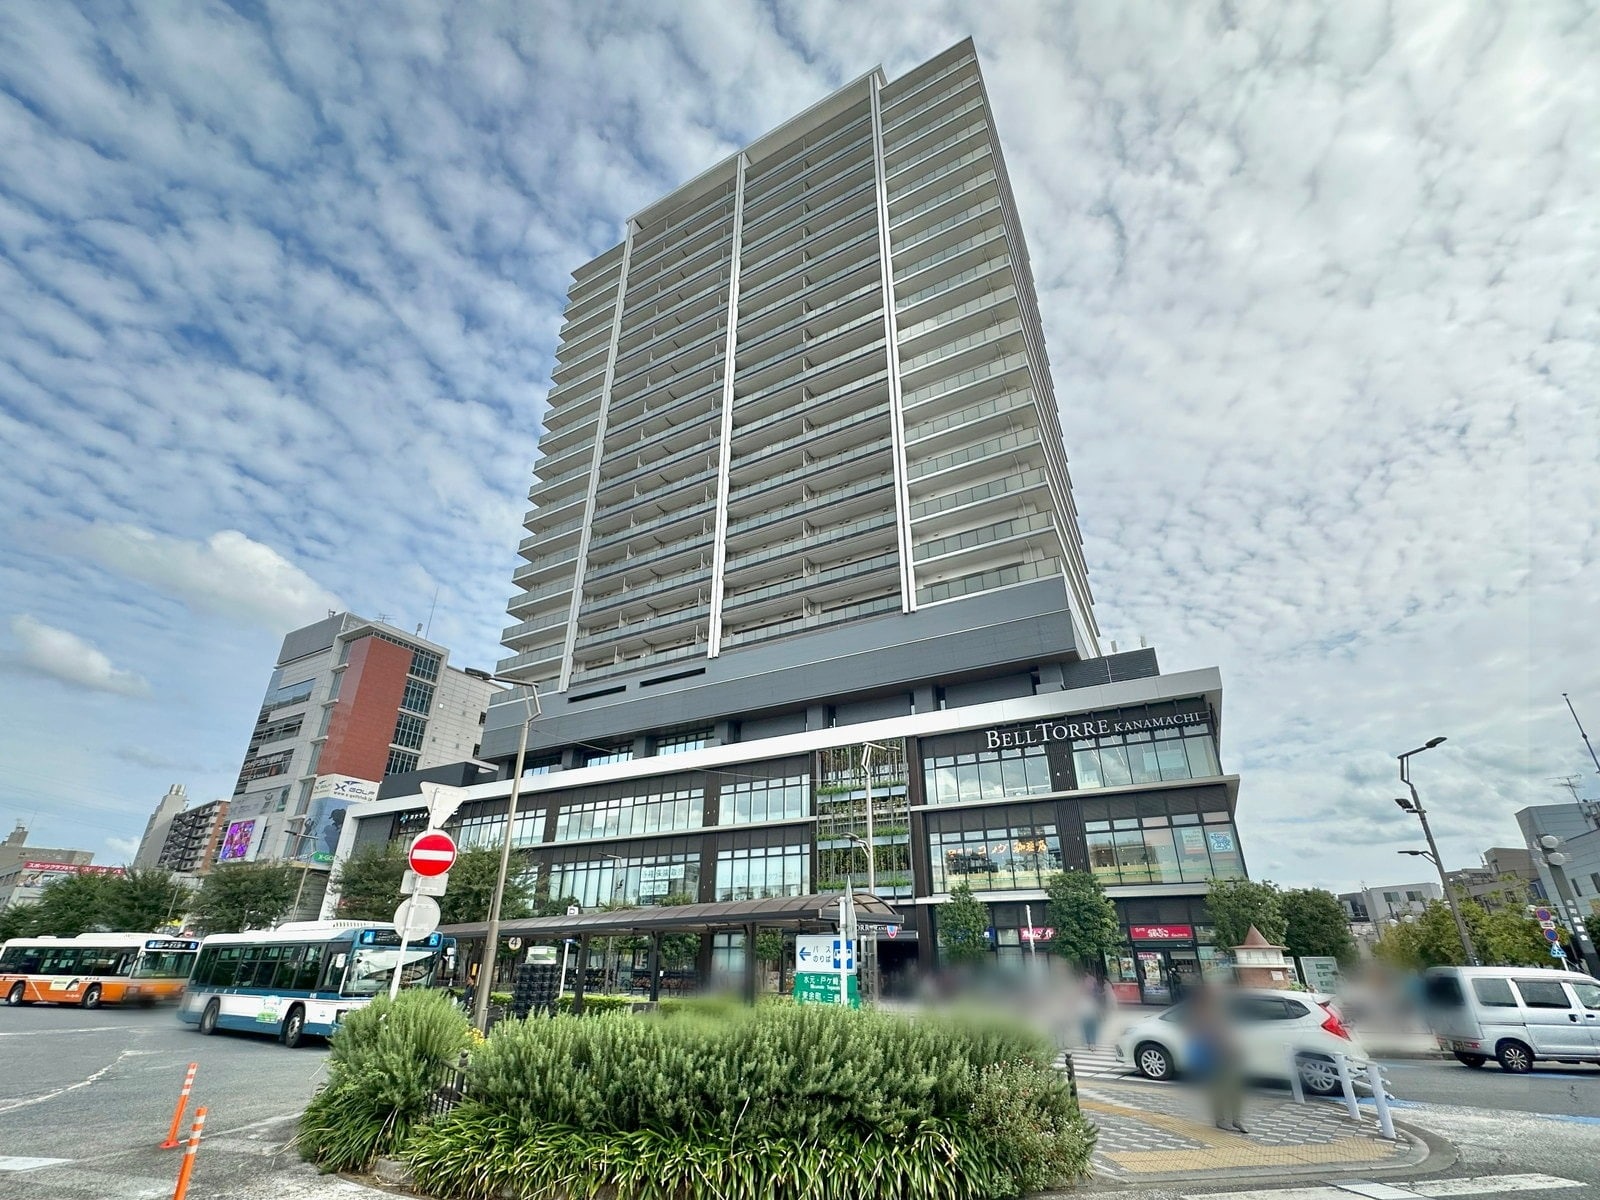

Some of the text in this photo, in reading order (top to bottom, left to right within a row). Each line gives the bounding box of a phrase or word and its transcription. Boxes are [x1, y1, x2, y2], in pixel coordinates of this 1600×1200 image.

[985, 712, 1200, 749] BELL TORRE KANAMACHI
[349, 787, 375, 797] GOLF
[813, 945, 831, 953] バス
